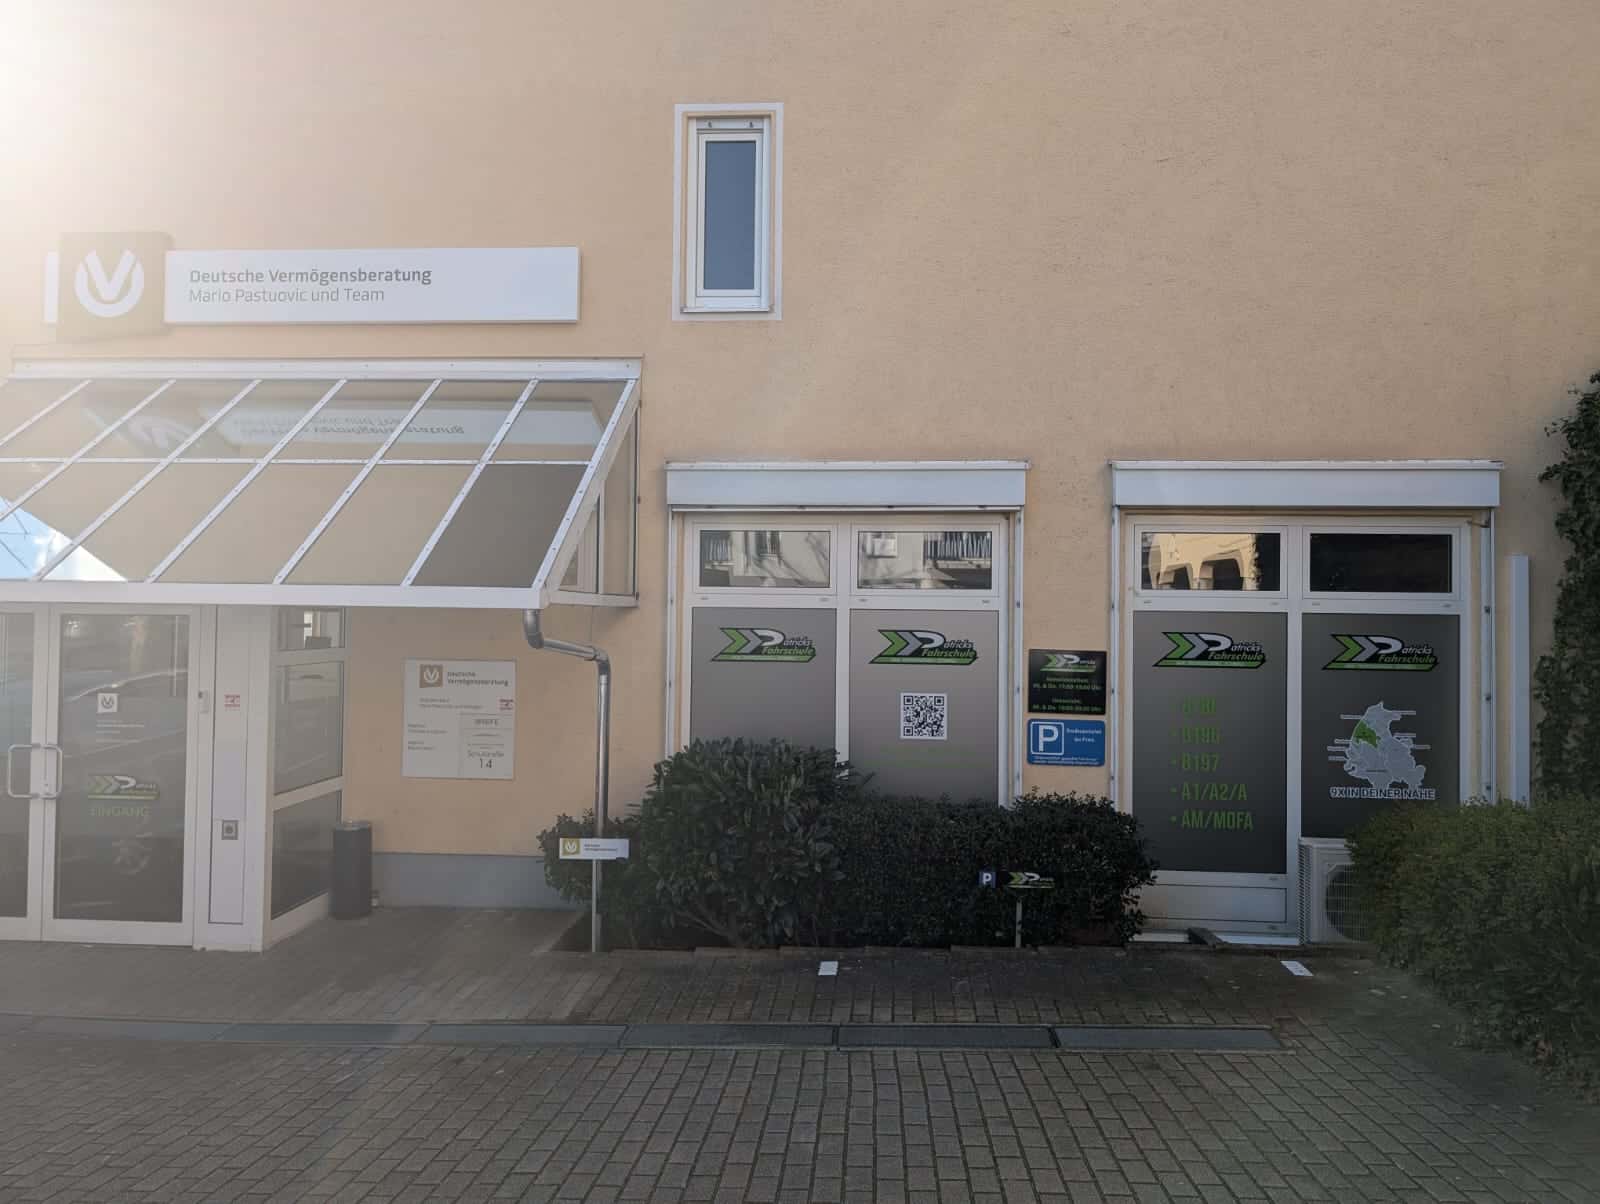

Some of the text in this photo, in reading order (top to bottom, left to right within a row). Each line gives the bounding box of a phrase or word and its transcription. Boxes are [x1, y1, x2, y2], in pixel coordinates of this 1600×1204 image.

[189, 268, 433, 286] Deutsche Vermögensberatung
[189, 287, 385, 302] Mario Pastuovic und Team
[761, 646, 814, 655] Fahrschule
[921, 648, 976, 657] Fahrschule
[1207, 651, 1264, 661] Fahrschule
[1378, 653, 1436, 664] Fahrschule
[1038, 724, 1059, 752] P
[1182, 754, 1219, 772] B197
[1181, 783, 1248, 801] A1/A2/A
[1346, 786, 1361, 798] IN
[1361, 786, 1403, 799] DEINER
[1181, 810, 1254, 830] AM/MOFA
